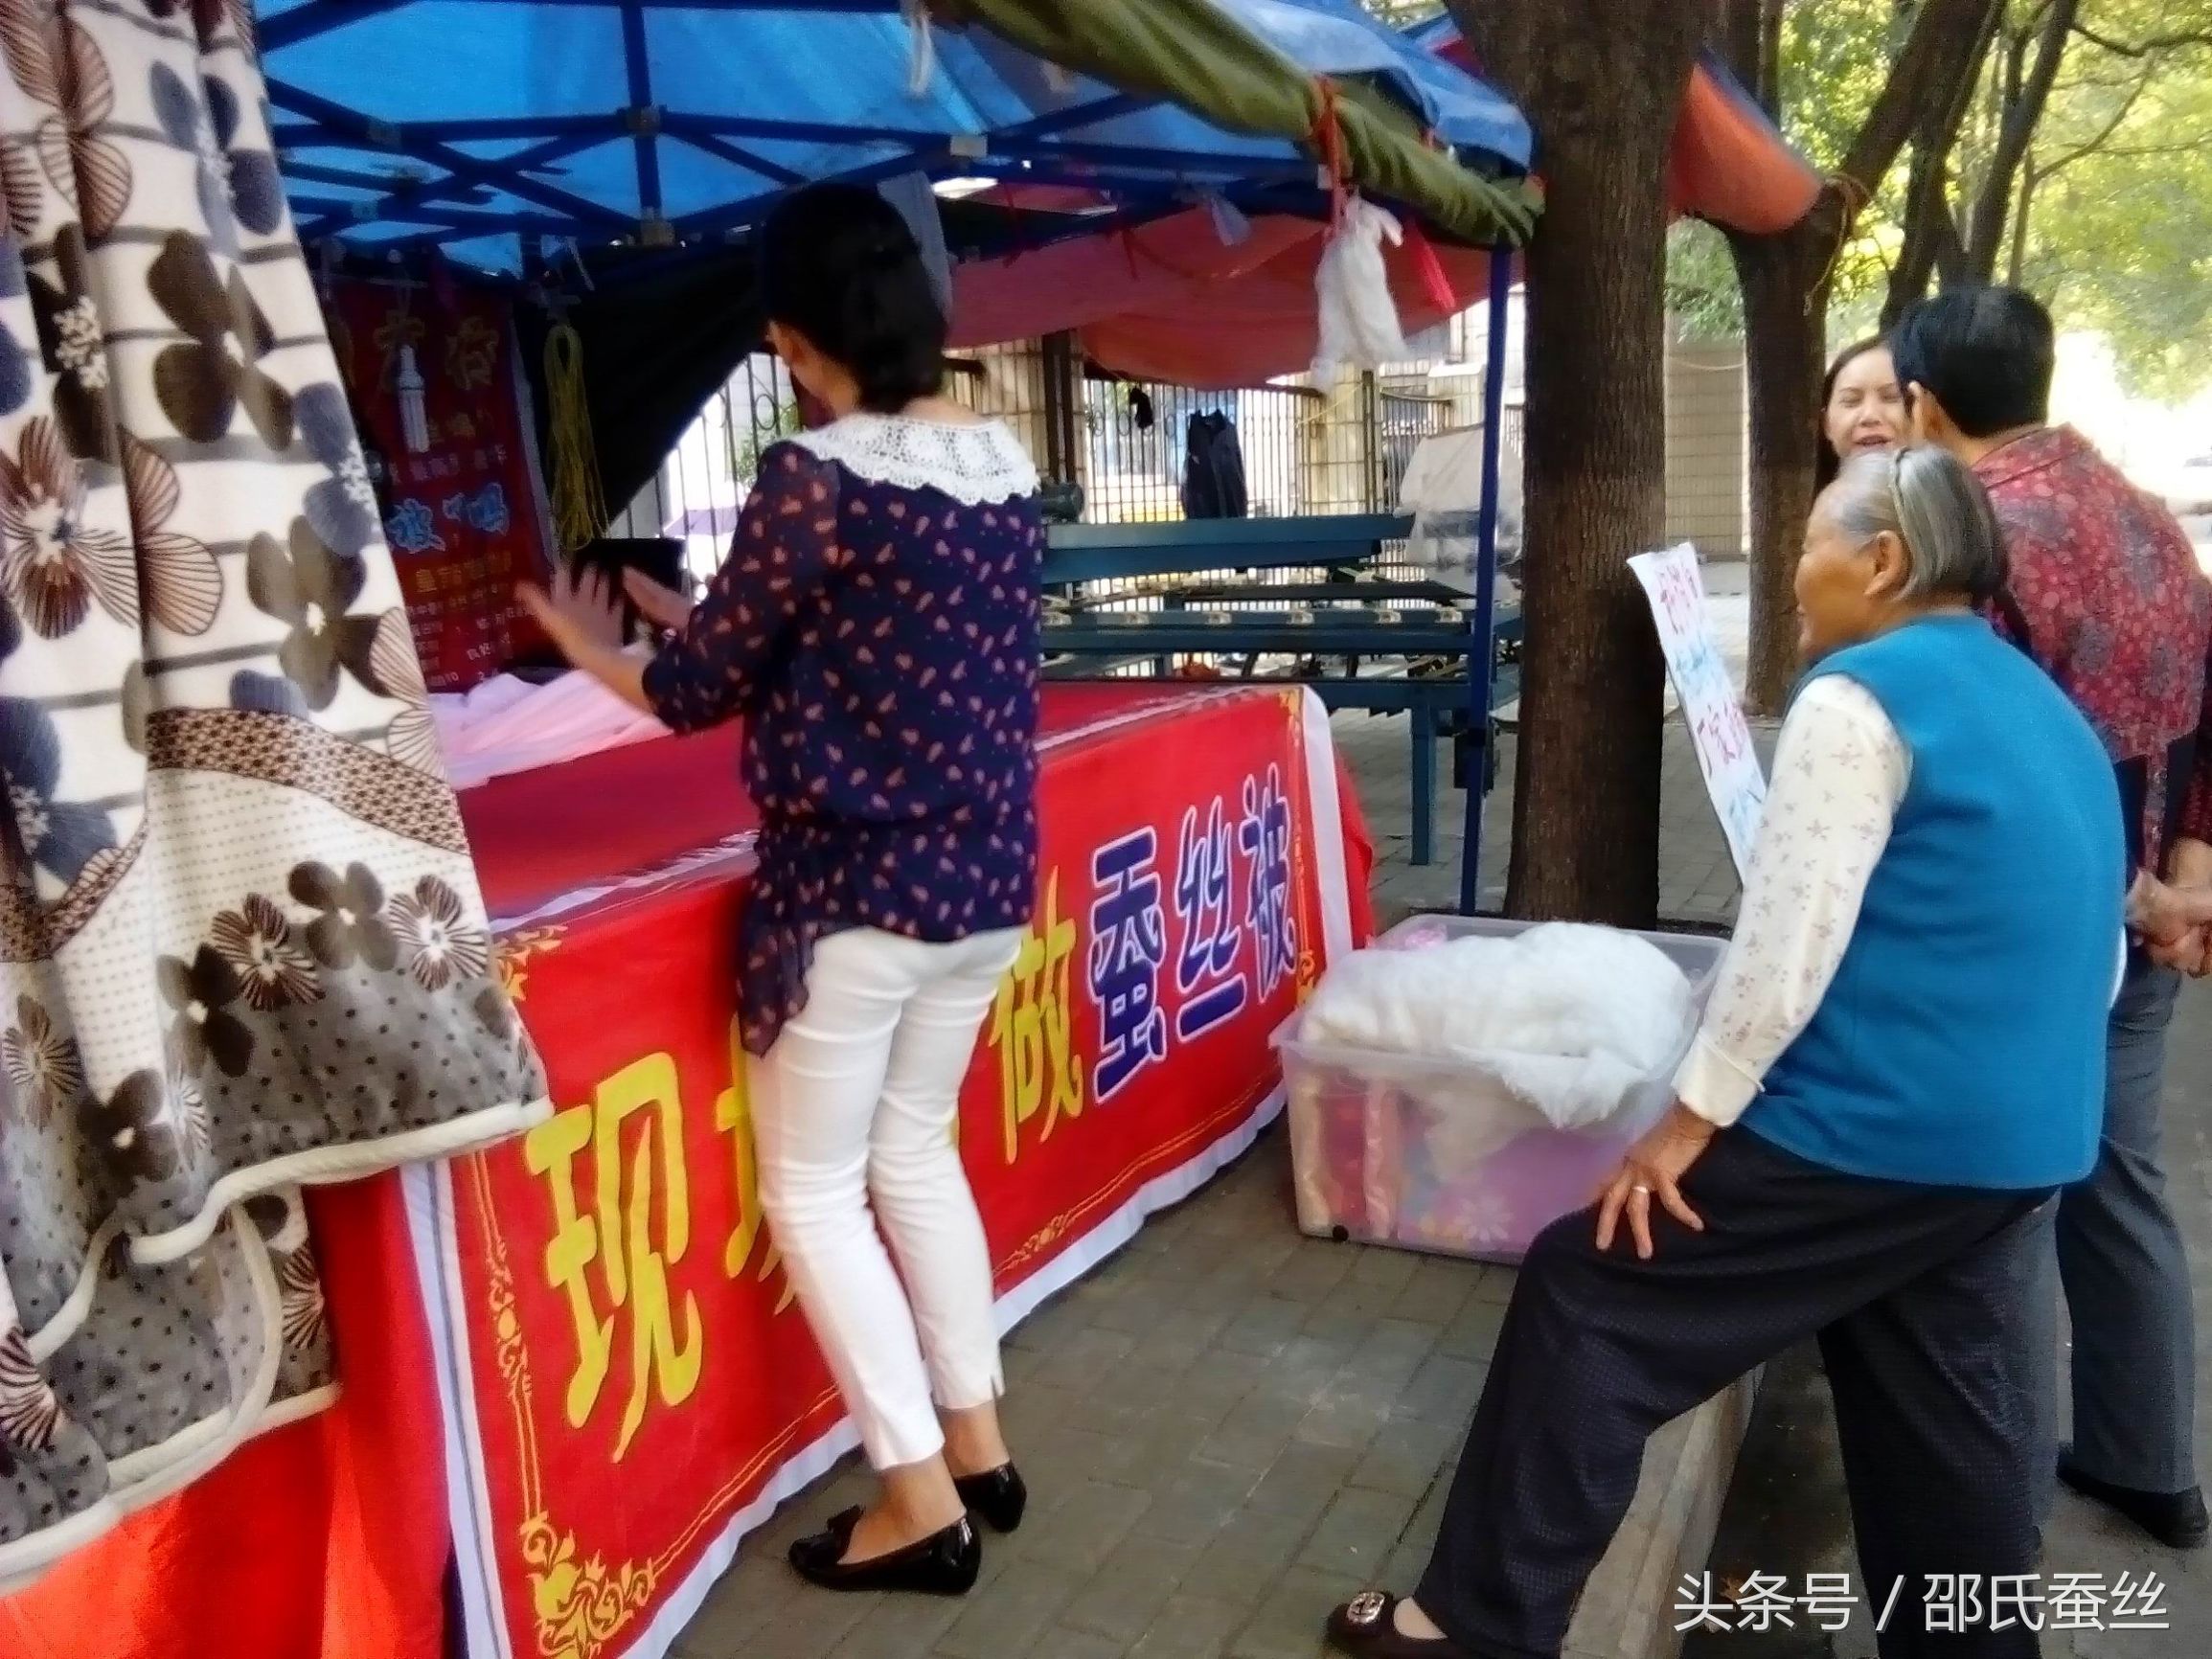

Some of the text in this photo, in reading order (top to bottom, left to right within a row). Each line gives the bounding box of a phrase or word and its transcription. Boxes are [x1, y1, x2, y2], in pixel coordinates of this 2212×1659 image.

[525, 762, 1296, 1464] 现做蚕丝被
